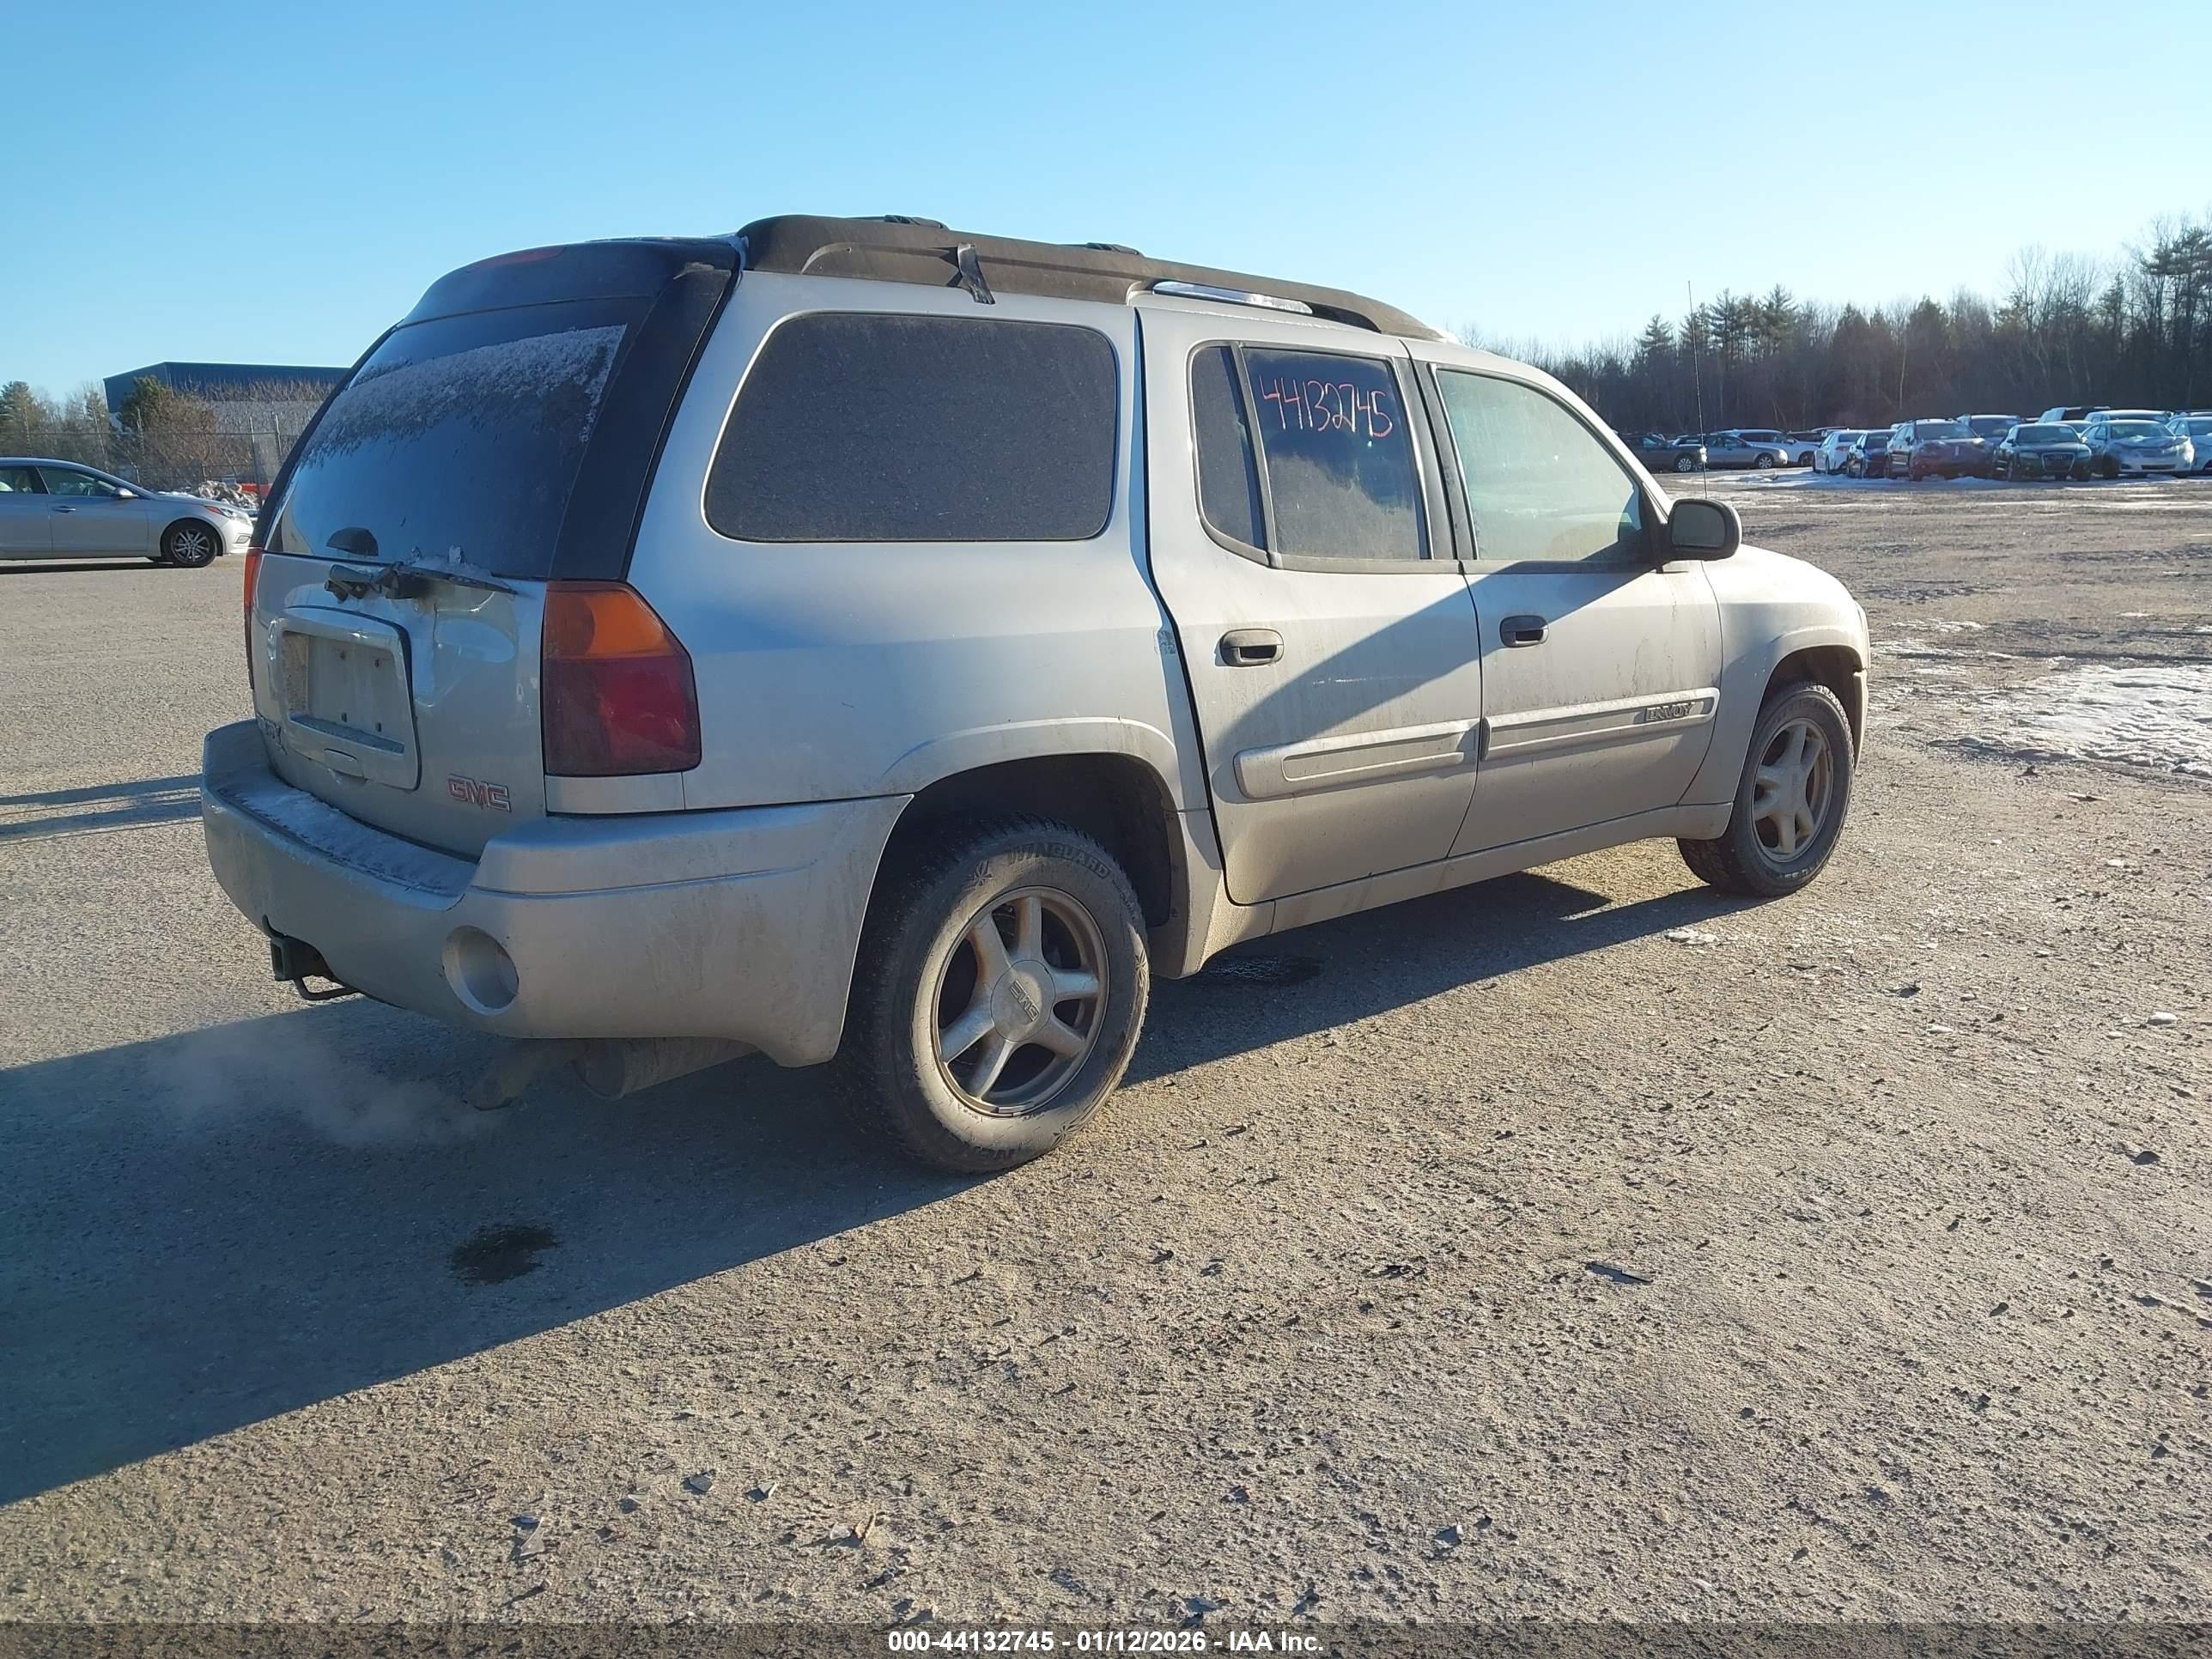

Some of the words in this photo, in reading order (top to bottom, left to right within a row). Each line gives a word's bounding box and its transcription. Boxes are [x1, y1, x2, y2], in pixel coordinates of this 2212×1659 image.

[1259, 375, 1394, 439] 44132745
[1644, 701, 1696, 722] ENVOY
[447, 773, 512, 813] GMC
[1010, 979, 1041, 1022] GMC
